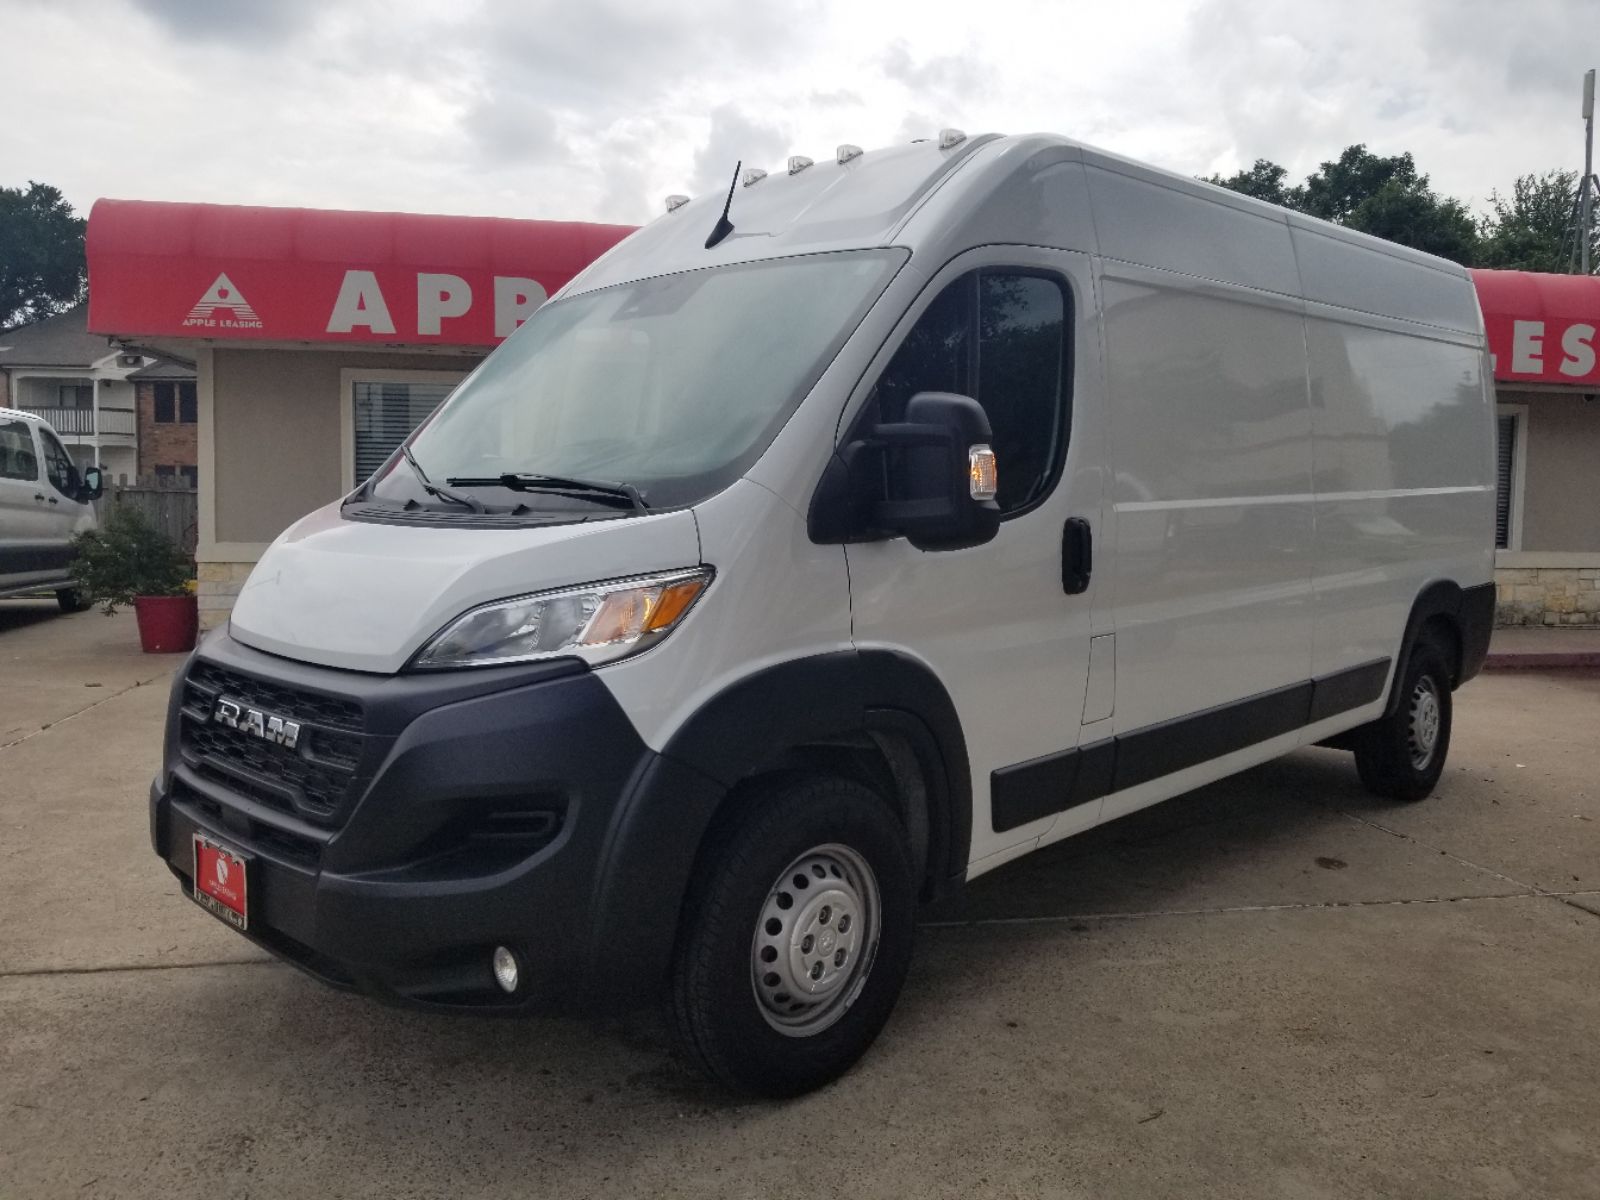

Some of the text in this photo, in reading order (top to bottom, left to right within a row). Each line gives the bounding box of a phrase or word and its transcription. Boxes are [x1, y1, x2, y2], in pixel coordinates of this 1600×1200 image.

[182, 318, 263, 328] APPLE LEASING
[214, 699, 300, 748] RAM
